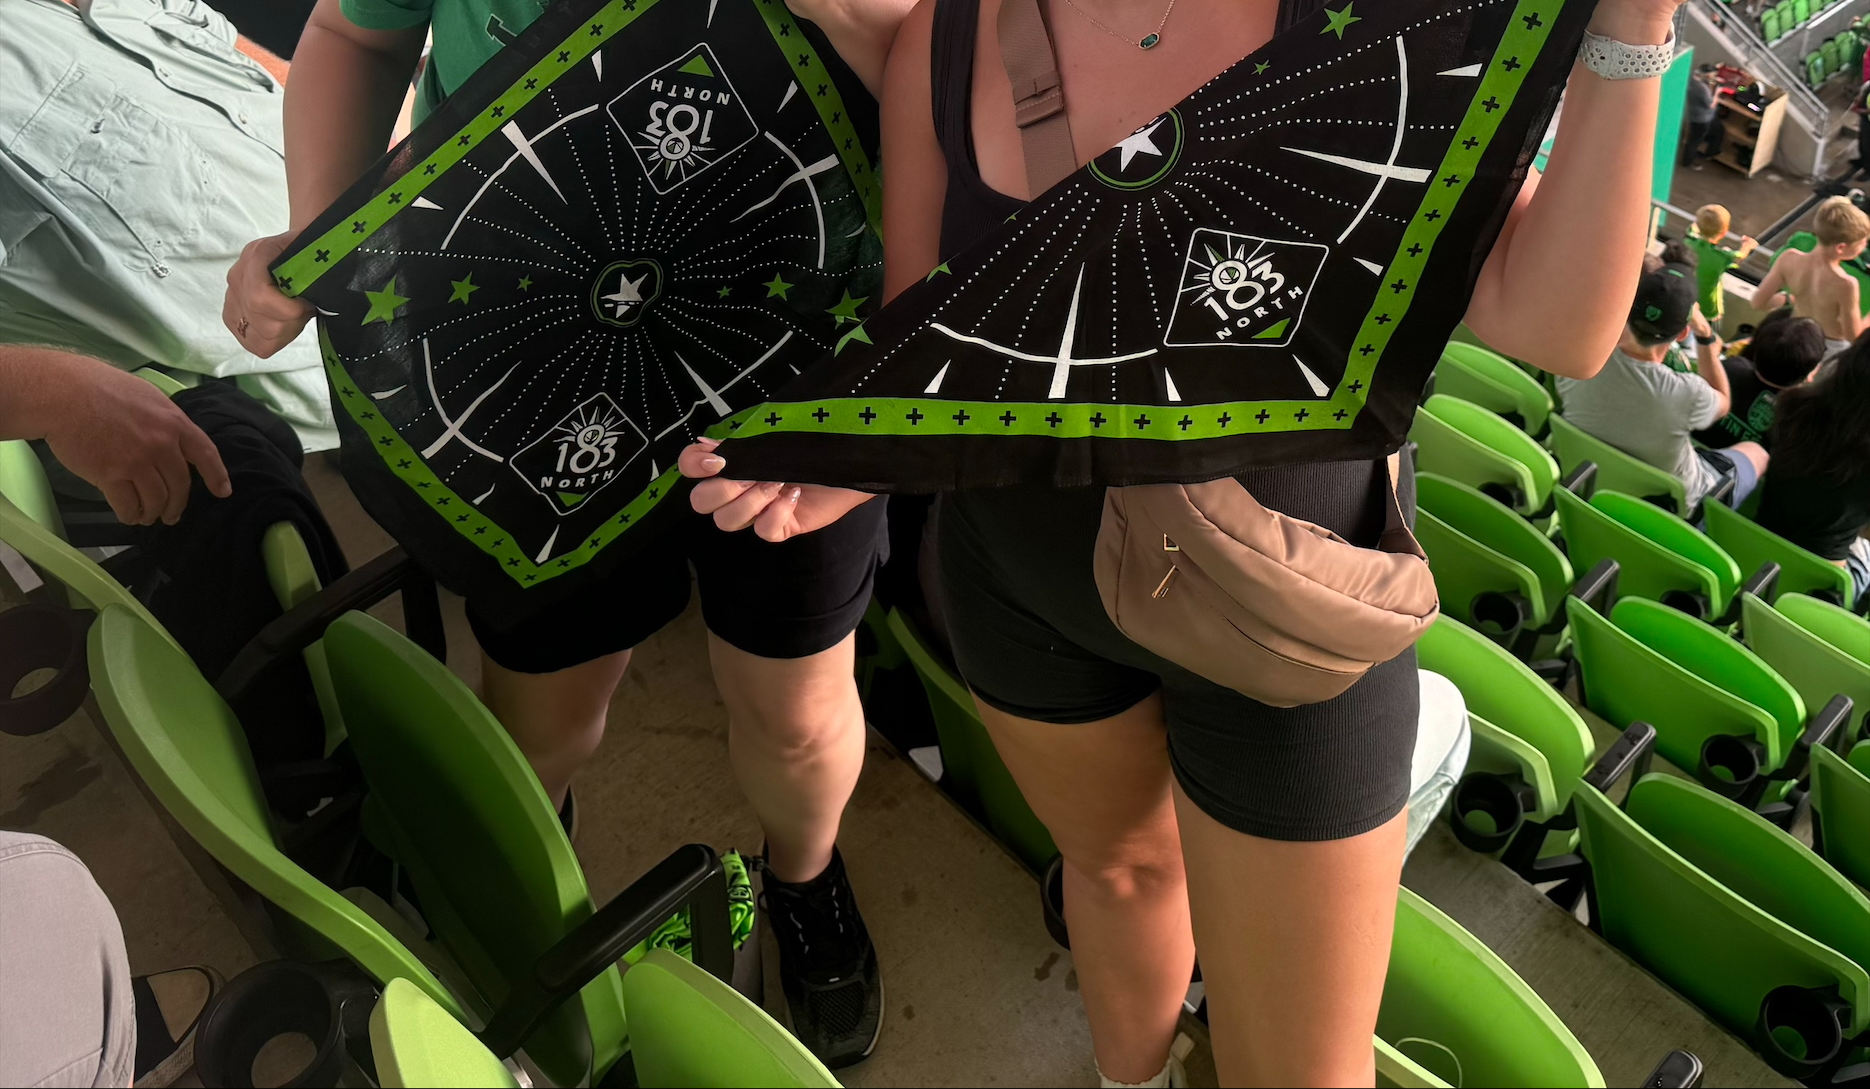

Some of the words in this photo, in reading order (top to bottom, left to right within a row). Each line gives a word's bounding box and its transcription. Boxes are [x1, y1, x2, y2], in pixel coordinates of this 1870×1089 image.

[651, 78, 731, 105] NORTH
[646, 101, 714, 160] 183
[1204, 260, 1285, 321] 183
[1216, 286, 1303, 340] NORTH
[556, 424, 618, 473] 183
[540, 469, 615, 488] NORTH
